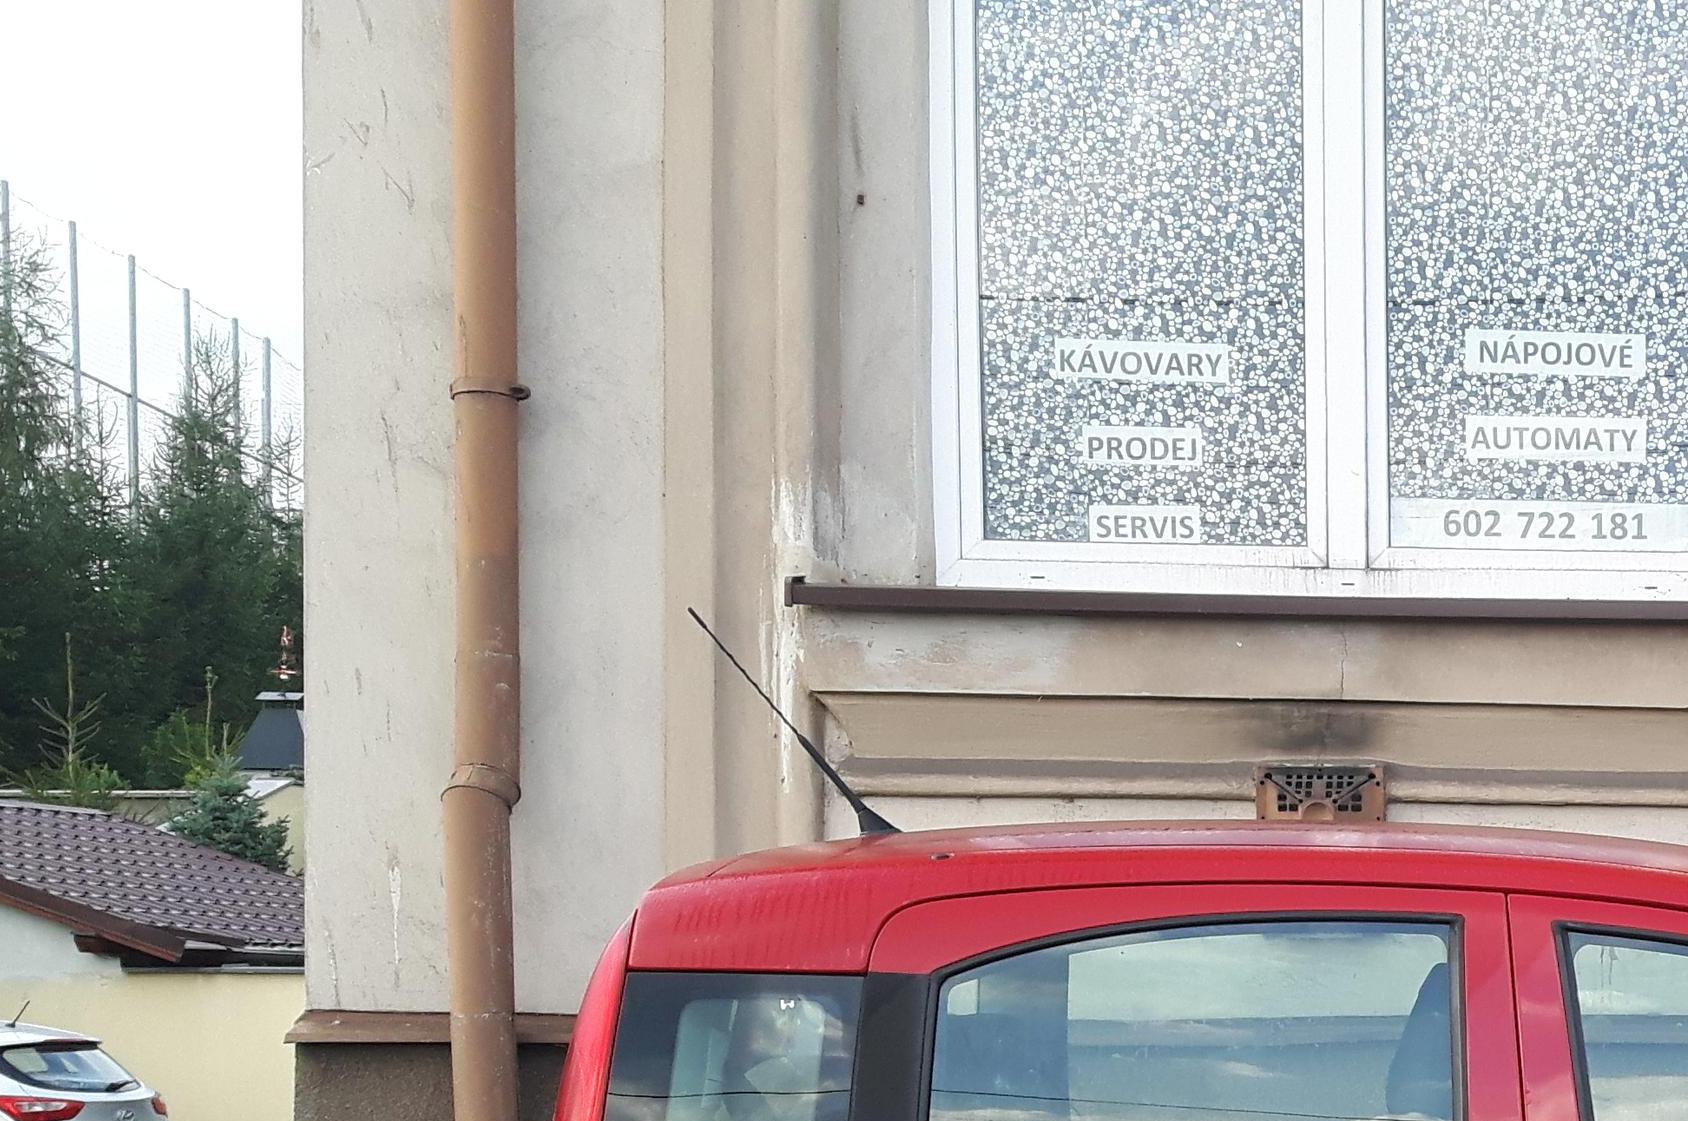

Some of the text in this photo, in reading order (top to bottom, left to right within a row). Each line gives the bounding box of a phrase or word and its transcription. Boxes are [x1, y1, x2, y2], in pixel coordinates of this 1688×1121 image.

[1059, 343, 1222, 377] KÁVOVARY
[1479, 334, 1633, 369] NÁPOJOVÉ
[1087, 436, 1197, 462] PRODEJ
[1471, 426, 1638, 453] AUTOMATY
[1096, 515, 1195, 539] SERVIS
[1443, 509, 1648, 540] 602 722 181
